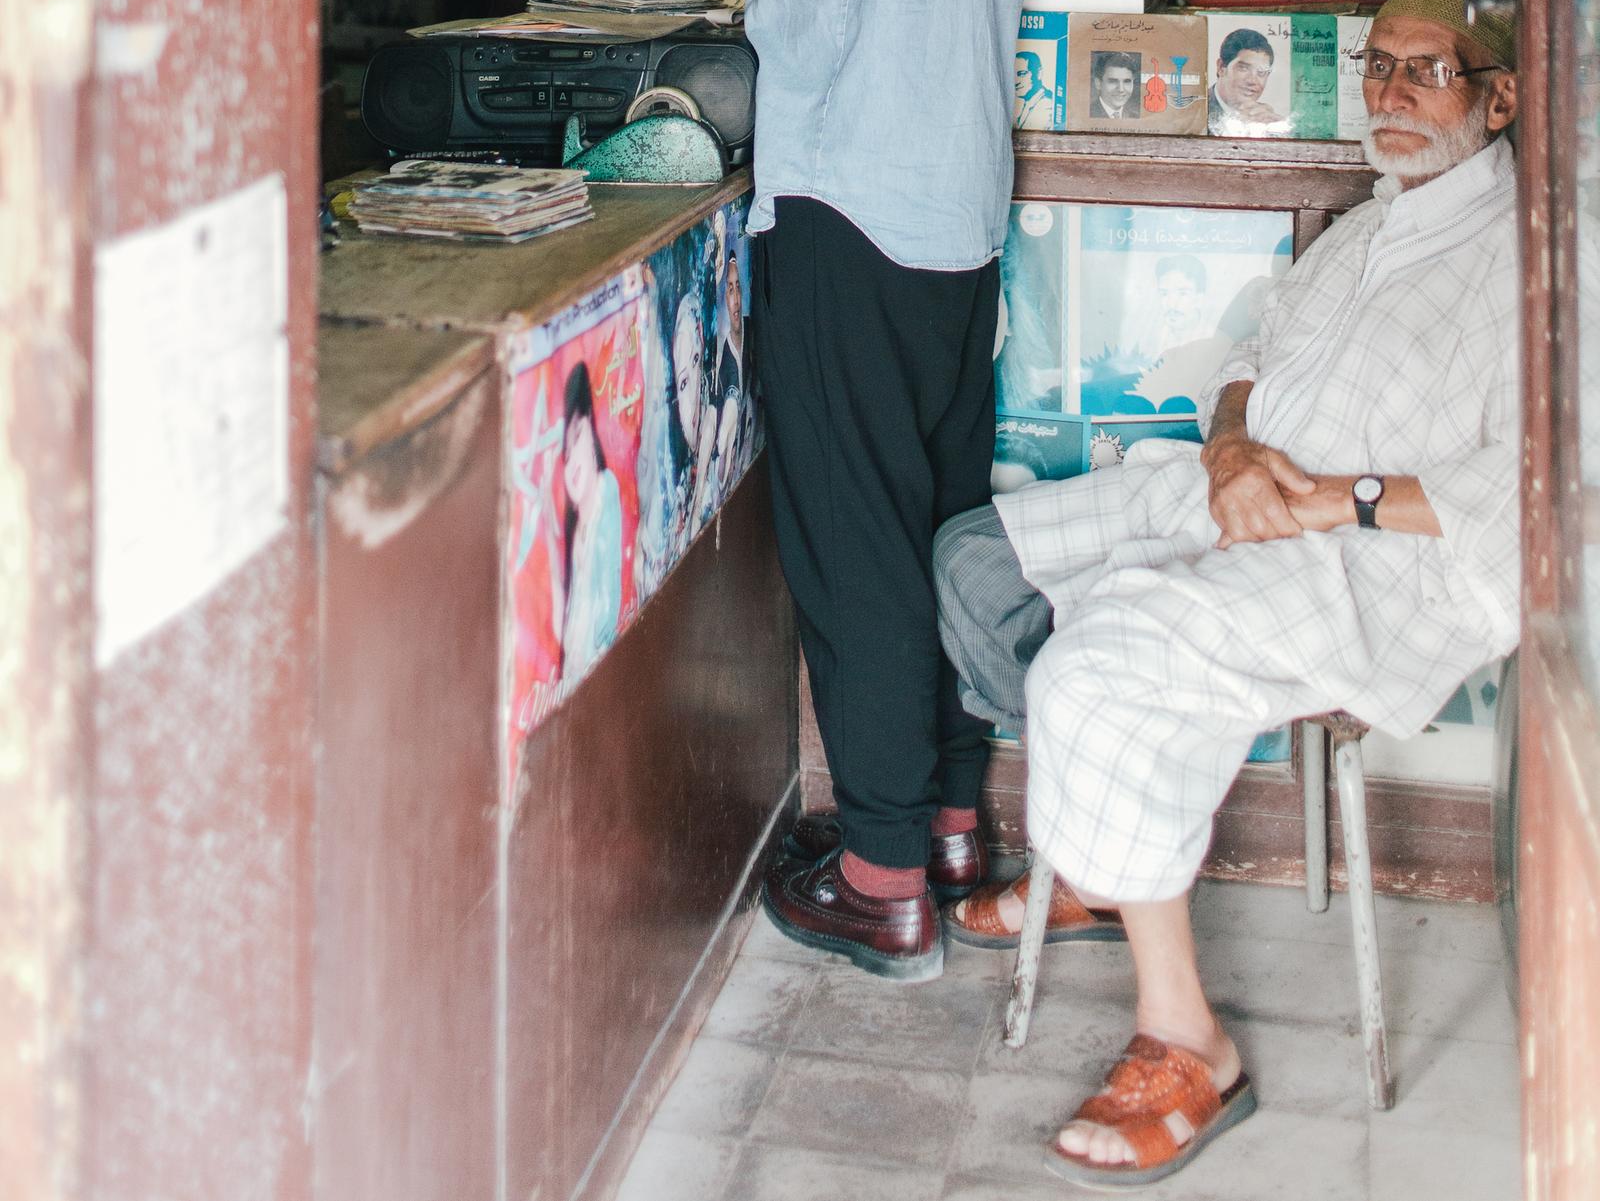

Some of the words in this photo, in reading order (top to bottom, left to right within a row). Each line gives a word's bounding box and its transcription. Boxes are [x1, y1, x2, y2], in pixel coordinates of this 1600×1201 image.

[538, 91, 545, 101] B
[559, 91, 567, 101] A
[1108, 228, 1151, 246] 1994
